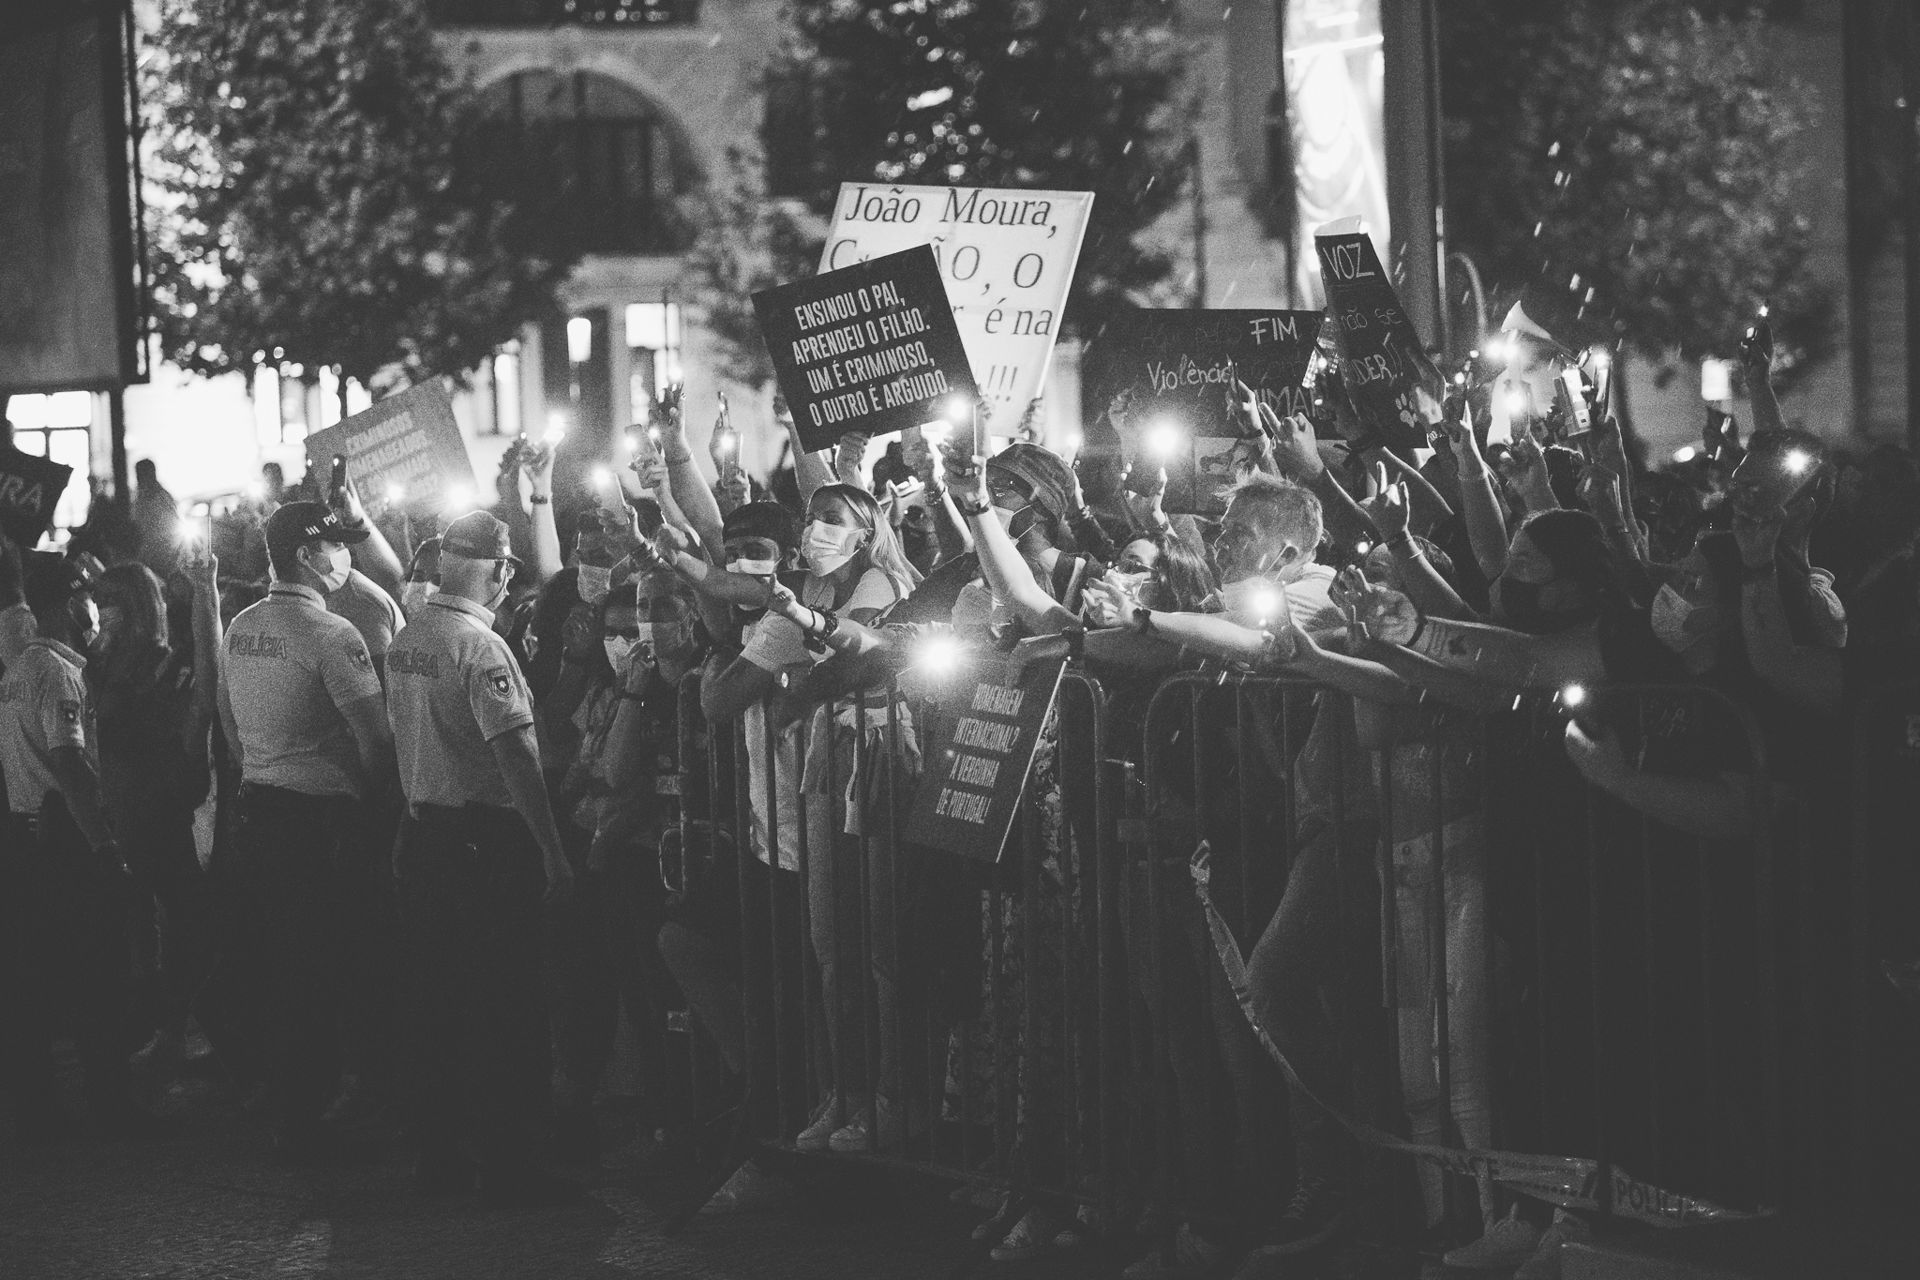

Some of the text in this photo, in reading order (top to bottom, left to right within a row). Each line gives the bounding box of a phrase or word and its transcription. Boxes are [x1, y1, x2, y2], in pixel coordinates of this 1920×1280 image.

[845, 187, 1058, 239] João Moura,
[1322, 242, 1375, 280] VOZ
[795, 280, 905, 331] ENSINOU O PAI,
[985, 298, 1052, 336] é na
[792, 308, 930, 365] APRENDEU O FILHO.
[1250, 316, 1298, 345] FIM
[806, 341, 935, 395] UM É CRIMINOSO,
[809, 369, 954, 427] O OUTRO É ARGUIDO.
[229, 631, 287, 661] POLÍCIA
[971, 683, 1025, 717] HOMENAGEM
[949, 753, 1000, 789] A VERGONHA
[935, 787, 952, 816] DE
